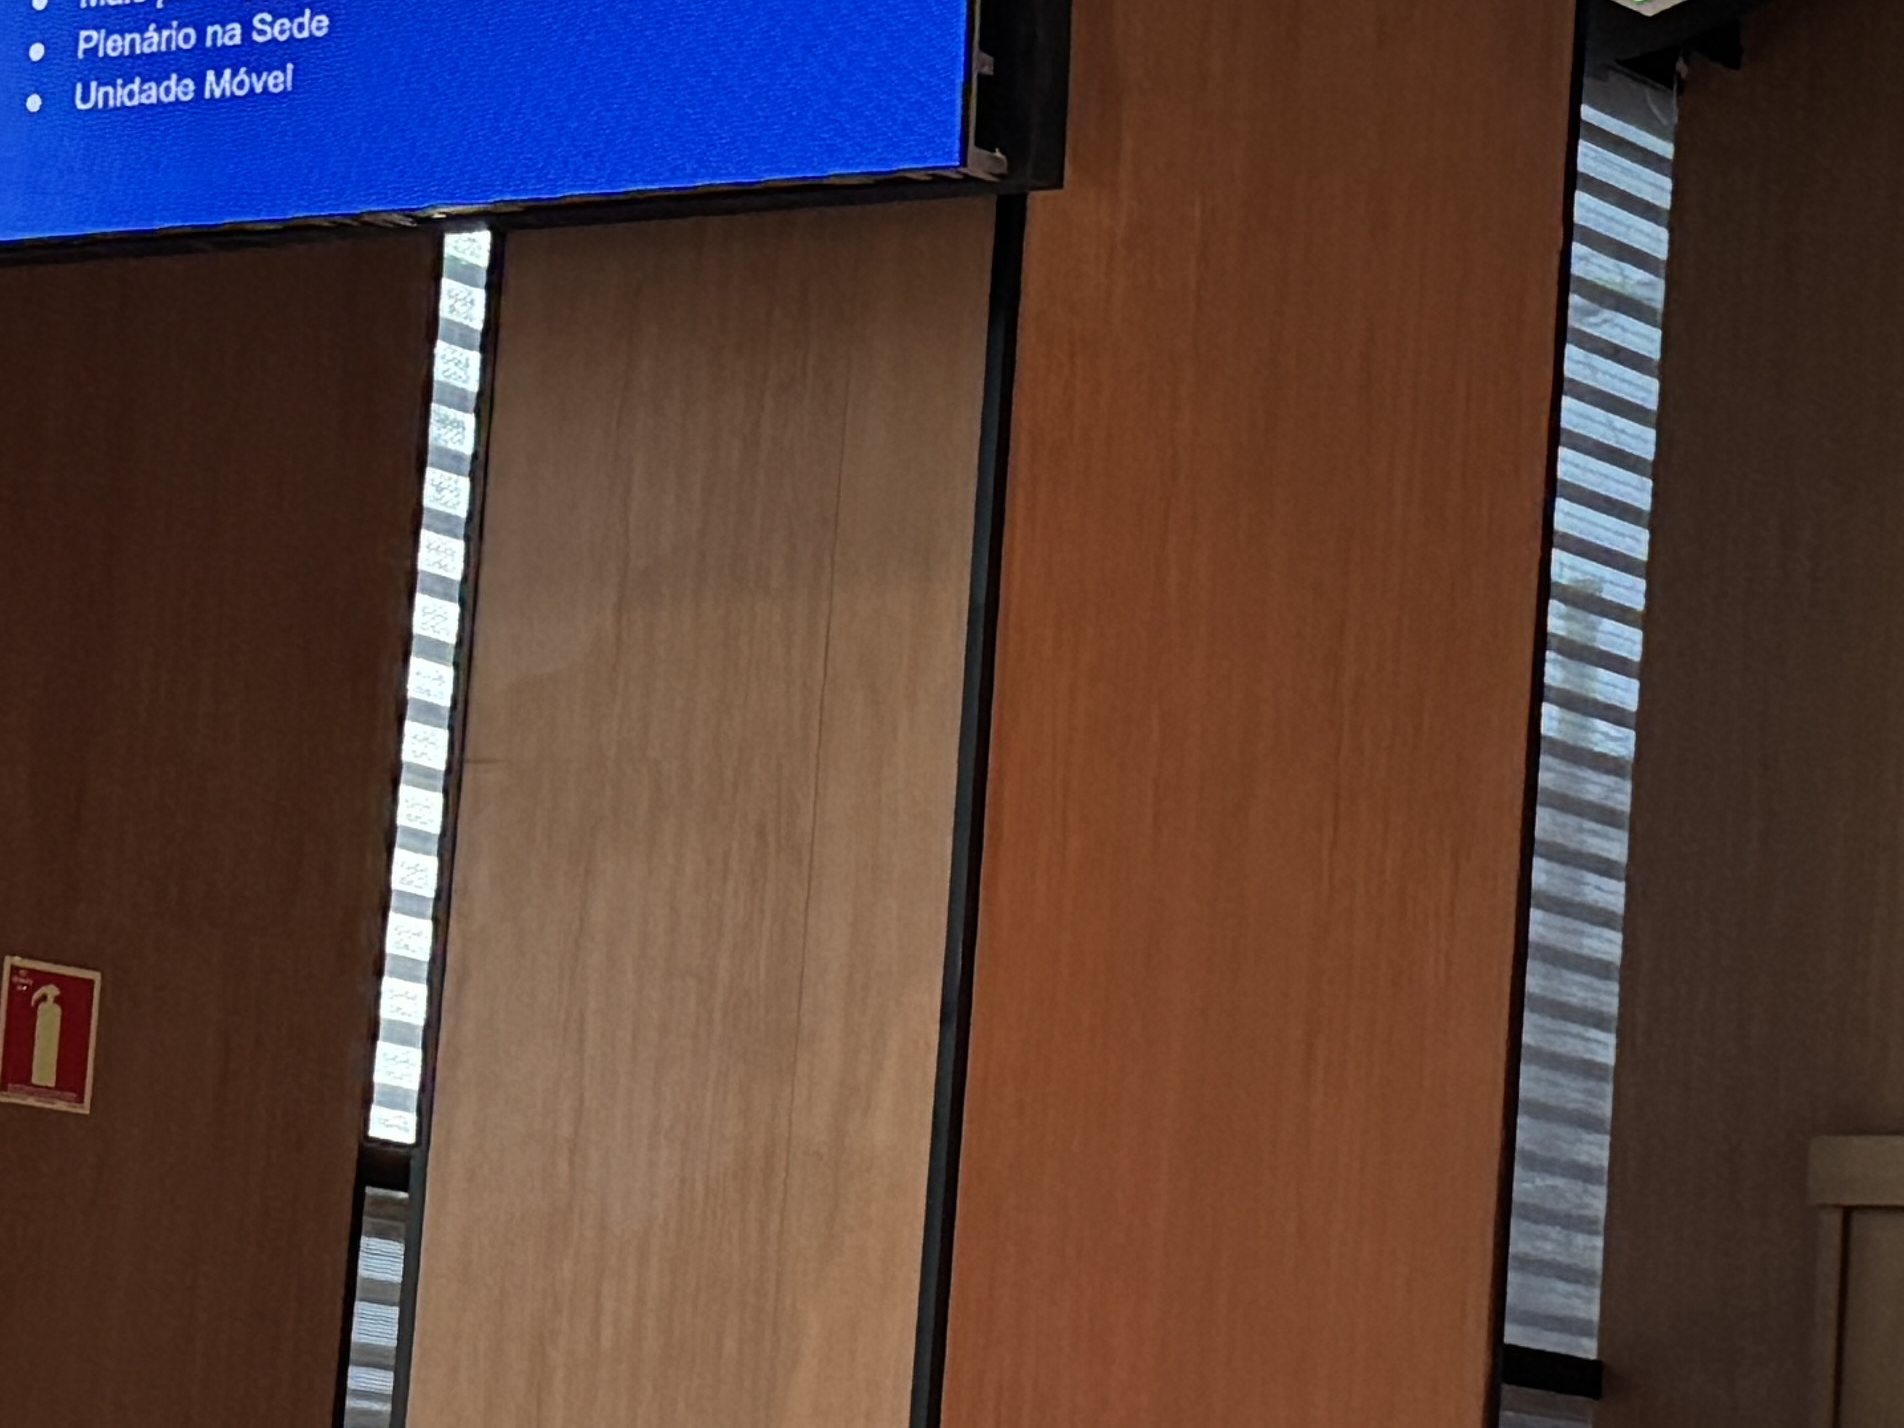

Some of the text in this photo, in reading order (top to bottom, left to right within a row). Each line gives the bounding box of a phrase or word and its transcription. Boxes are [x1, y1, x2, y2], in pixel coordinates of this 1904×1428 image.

[77, 8, 330, 59] Plenário na Sede
[75, 63, 294, 110] Unidade Móvel
